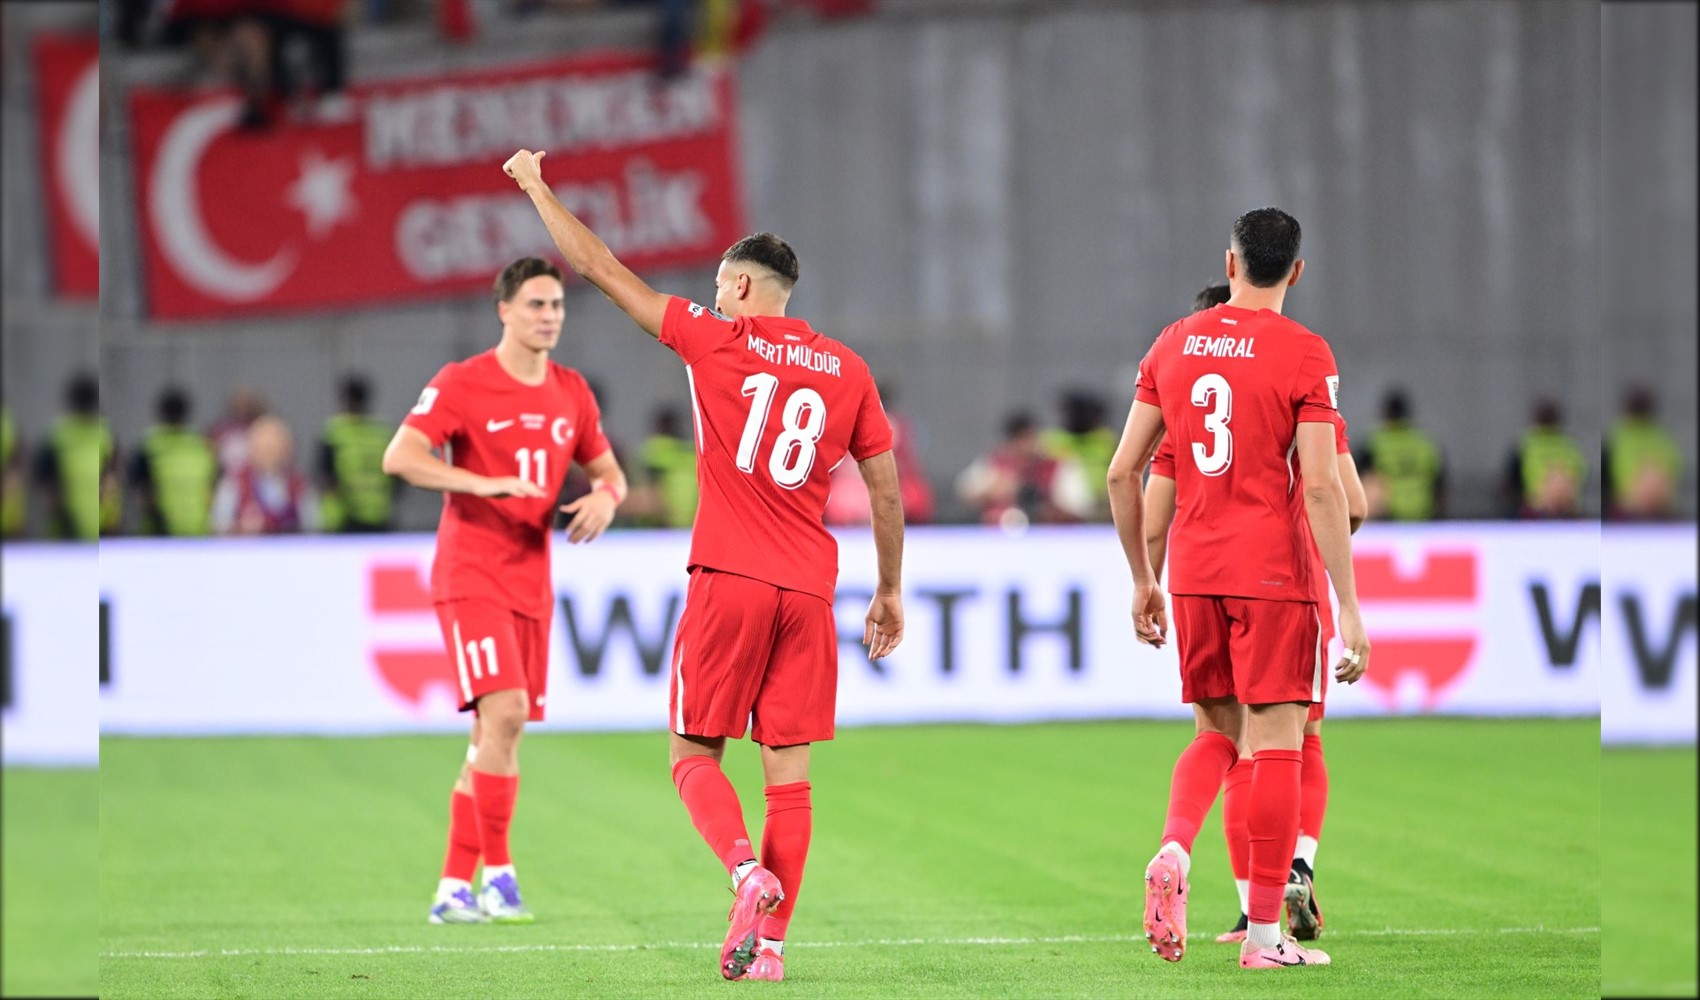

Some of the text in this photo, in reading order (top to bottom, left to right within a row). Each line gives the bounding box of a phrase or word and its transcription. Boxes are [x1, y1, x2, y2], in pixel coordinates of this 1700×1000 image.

[747, 334, 841, 378] MERT MÜLDÜR
[1183, 334, 1255, 358] DEMİRAL
[736, 372, 826, 490] 18
[1191, 373, 1233, 477] 3
[515, 448, 547, 488] 11
[560, 587, 1085, 677] WRTH
[466, 636, 499, 679] 11
